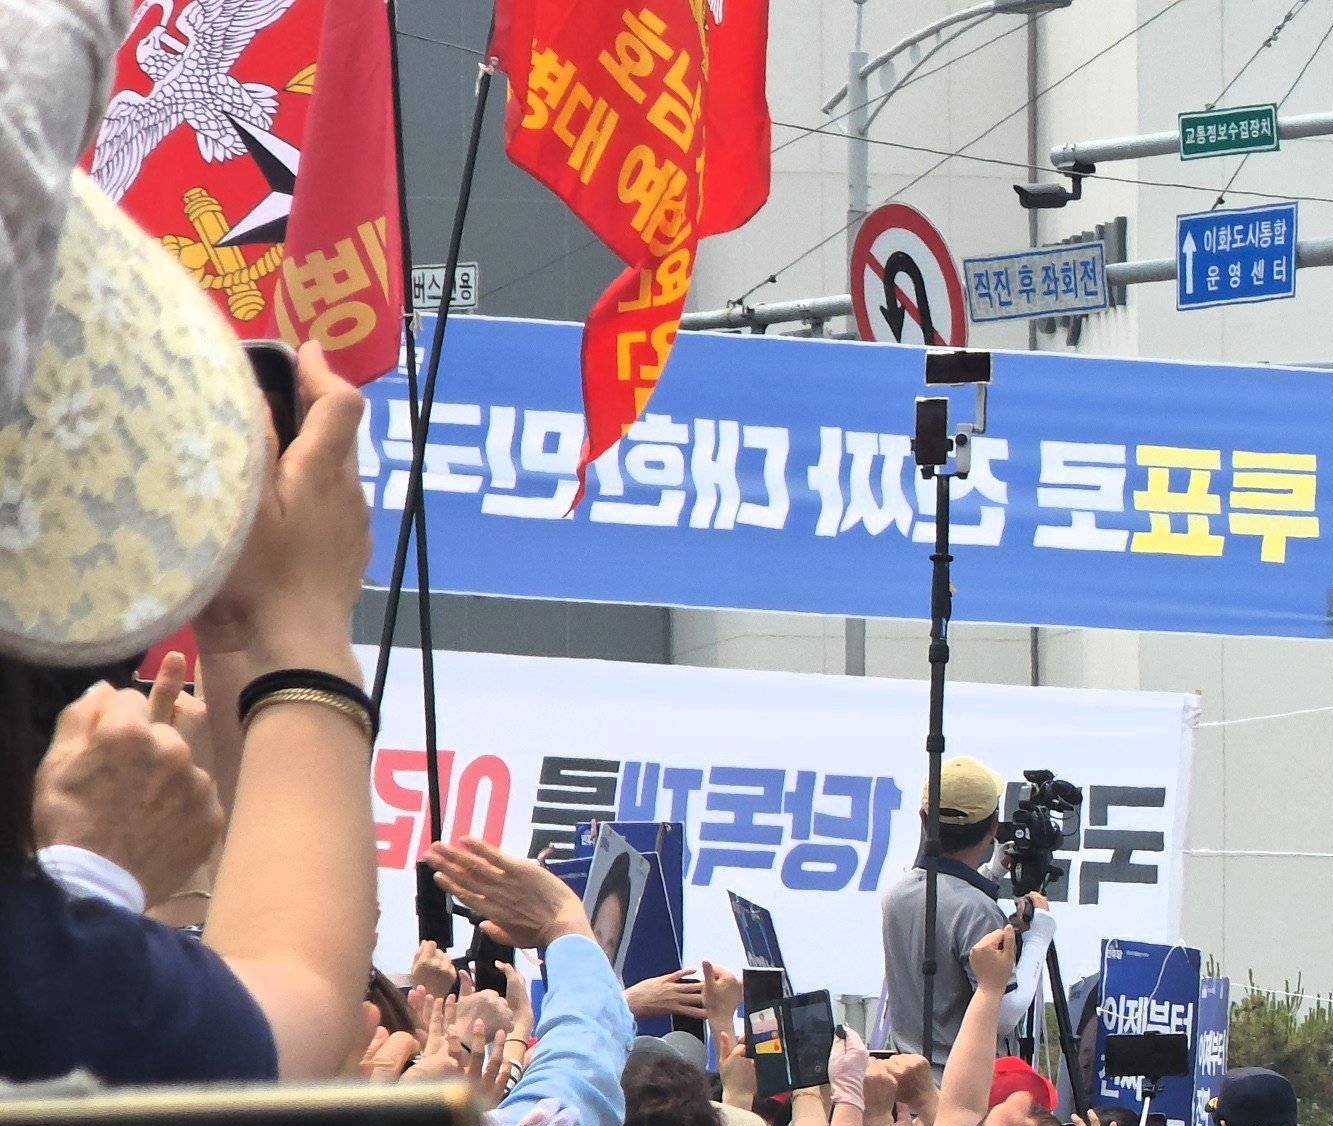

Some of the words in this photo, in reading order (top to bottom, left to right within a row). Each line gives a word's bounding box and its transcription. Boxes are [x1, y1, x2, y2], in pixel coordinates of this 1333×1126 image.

[1185, 117, 1271, 146] 교통정보수집장치
[1203, 218, 1287, 254] 이화도시통합
[413, 270, 473, 304] 버스용
[973, 266, 1012, 308] 직진
[1018, 267, 1035, 297] 후
[1042, 256, 1099, 301] 좌회전
